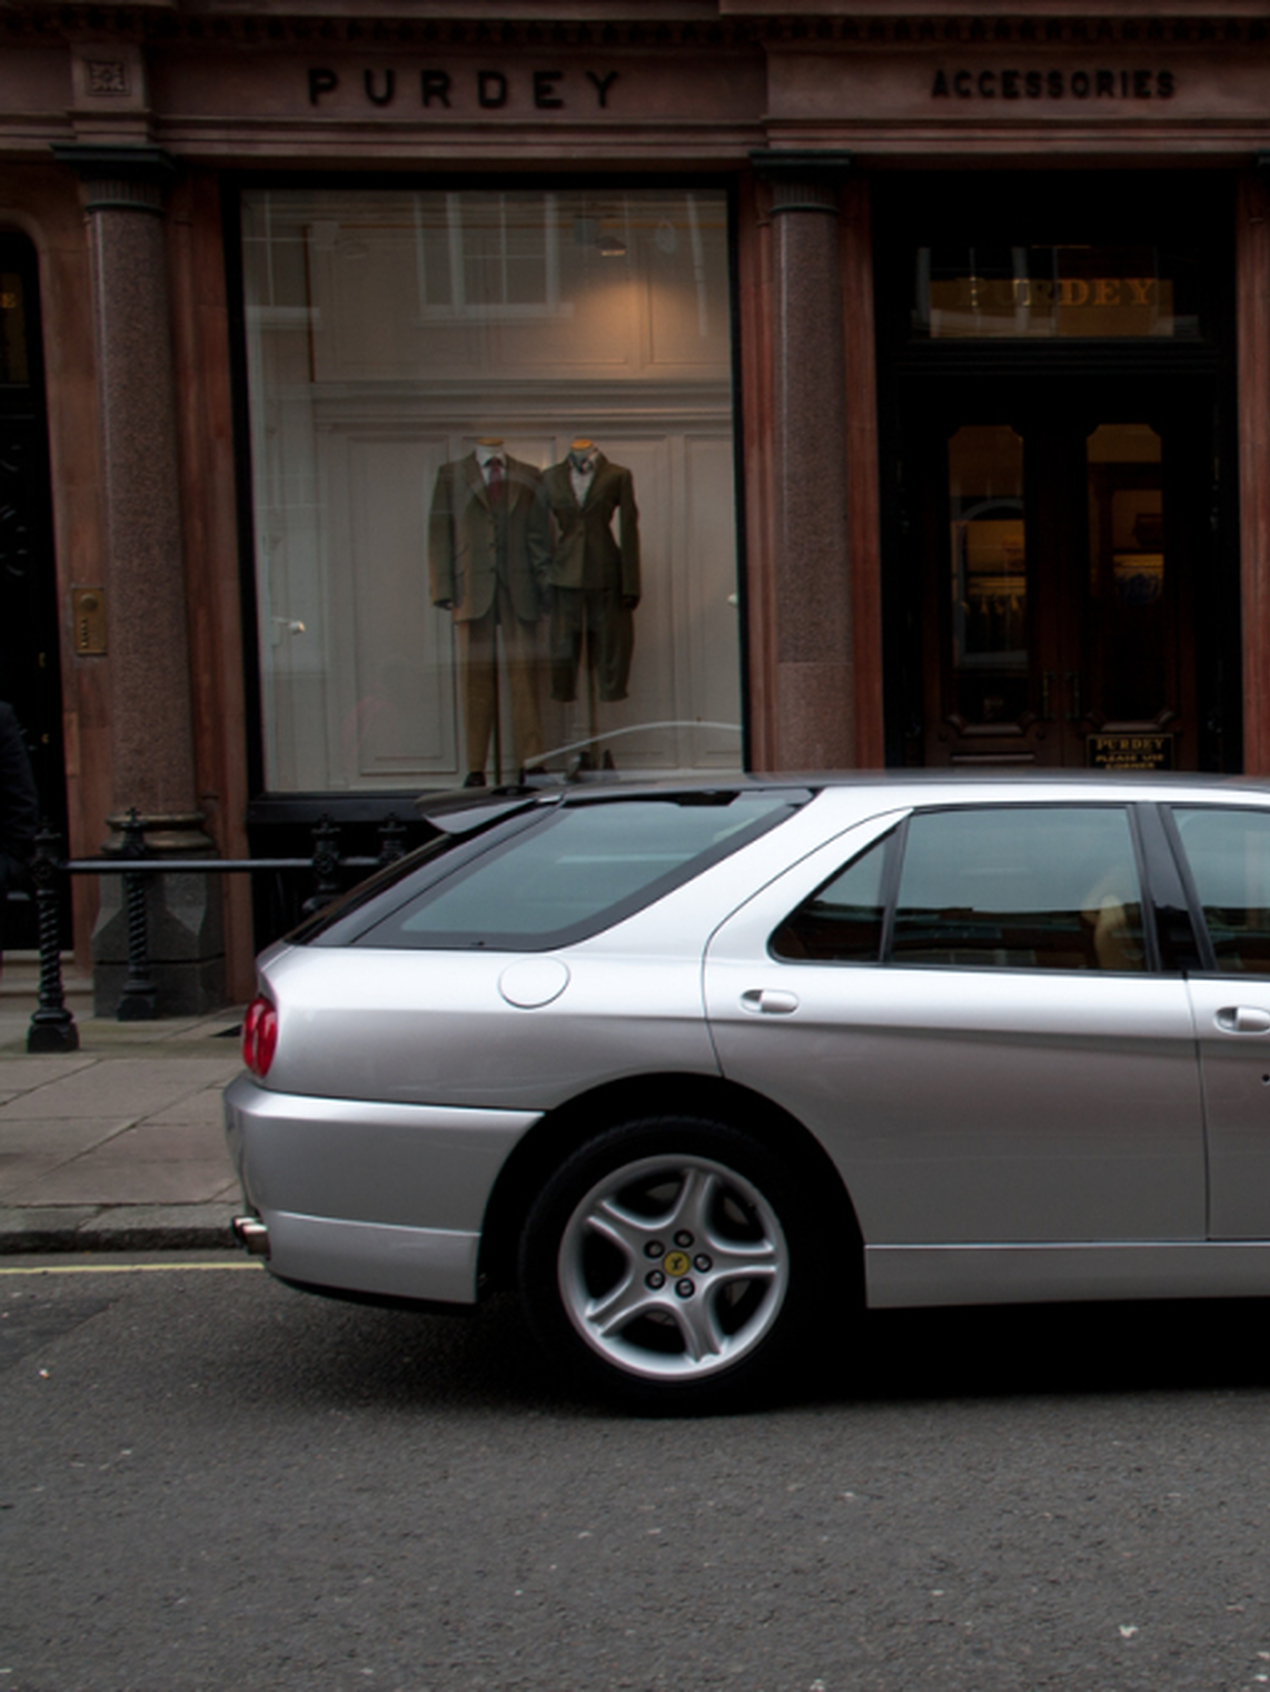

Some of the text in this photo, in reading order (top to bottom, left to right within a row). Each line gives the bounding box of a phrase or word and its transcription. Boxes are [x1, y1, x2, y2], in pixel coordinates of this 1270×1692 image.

[307, 67, 619, 110] PURDEY
[930, 68, 1177, 99] ACCESSORIES
[955, 276, 1157, 307] PURDEY
[1095, 738, 1165, 751] PURDEY
